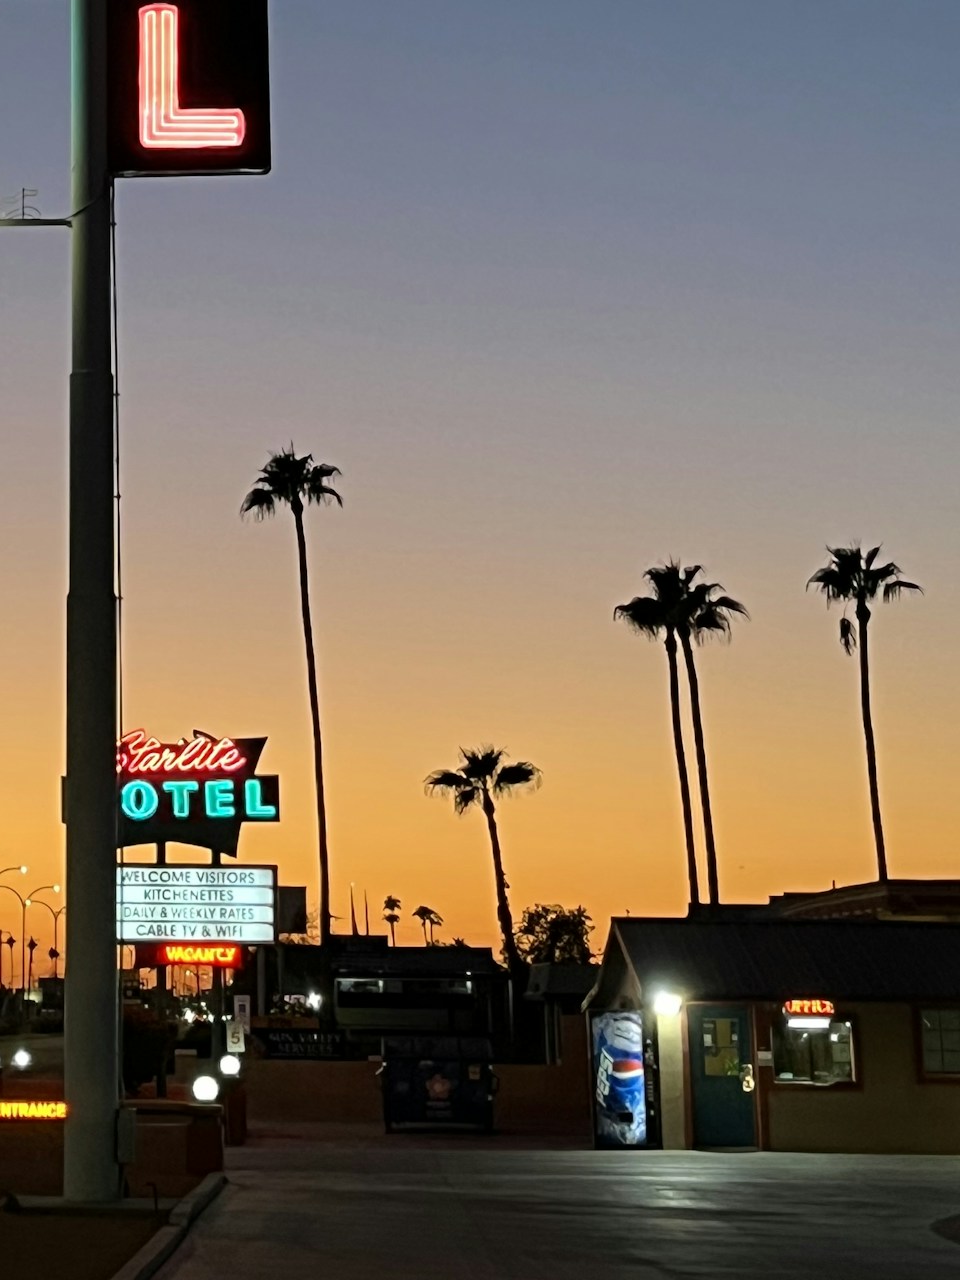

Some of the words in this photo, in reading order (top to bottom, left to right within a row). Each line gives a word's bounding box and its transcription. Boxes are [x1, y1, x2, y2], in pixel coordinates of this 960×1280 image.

[121, 779, 276, 820] OTEL
[122, 871, 191, 883] WELCOME
[196, 871, 255, 884] VISITORS
[144, 889, 234, 901] KITCHENETTES
[124, 907, 156, 918] DAILY
[160, 907, 168, 918] &
[171, 907, 216, 919] WEEKLY
[220, 907, 255, 920] RATES
[136, 924, 176, 936] CABLE
[182, 925, 197, 937] TV
[201, 925, 211, 937] &
[215, 925, 243, 937] WIFI
[165, 946, 236, 963] VACANCY
[783, 1000, 835, 1014] OFFICE
[230, 1031, 240, 1044] 5
